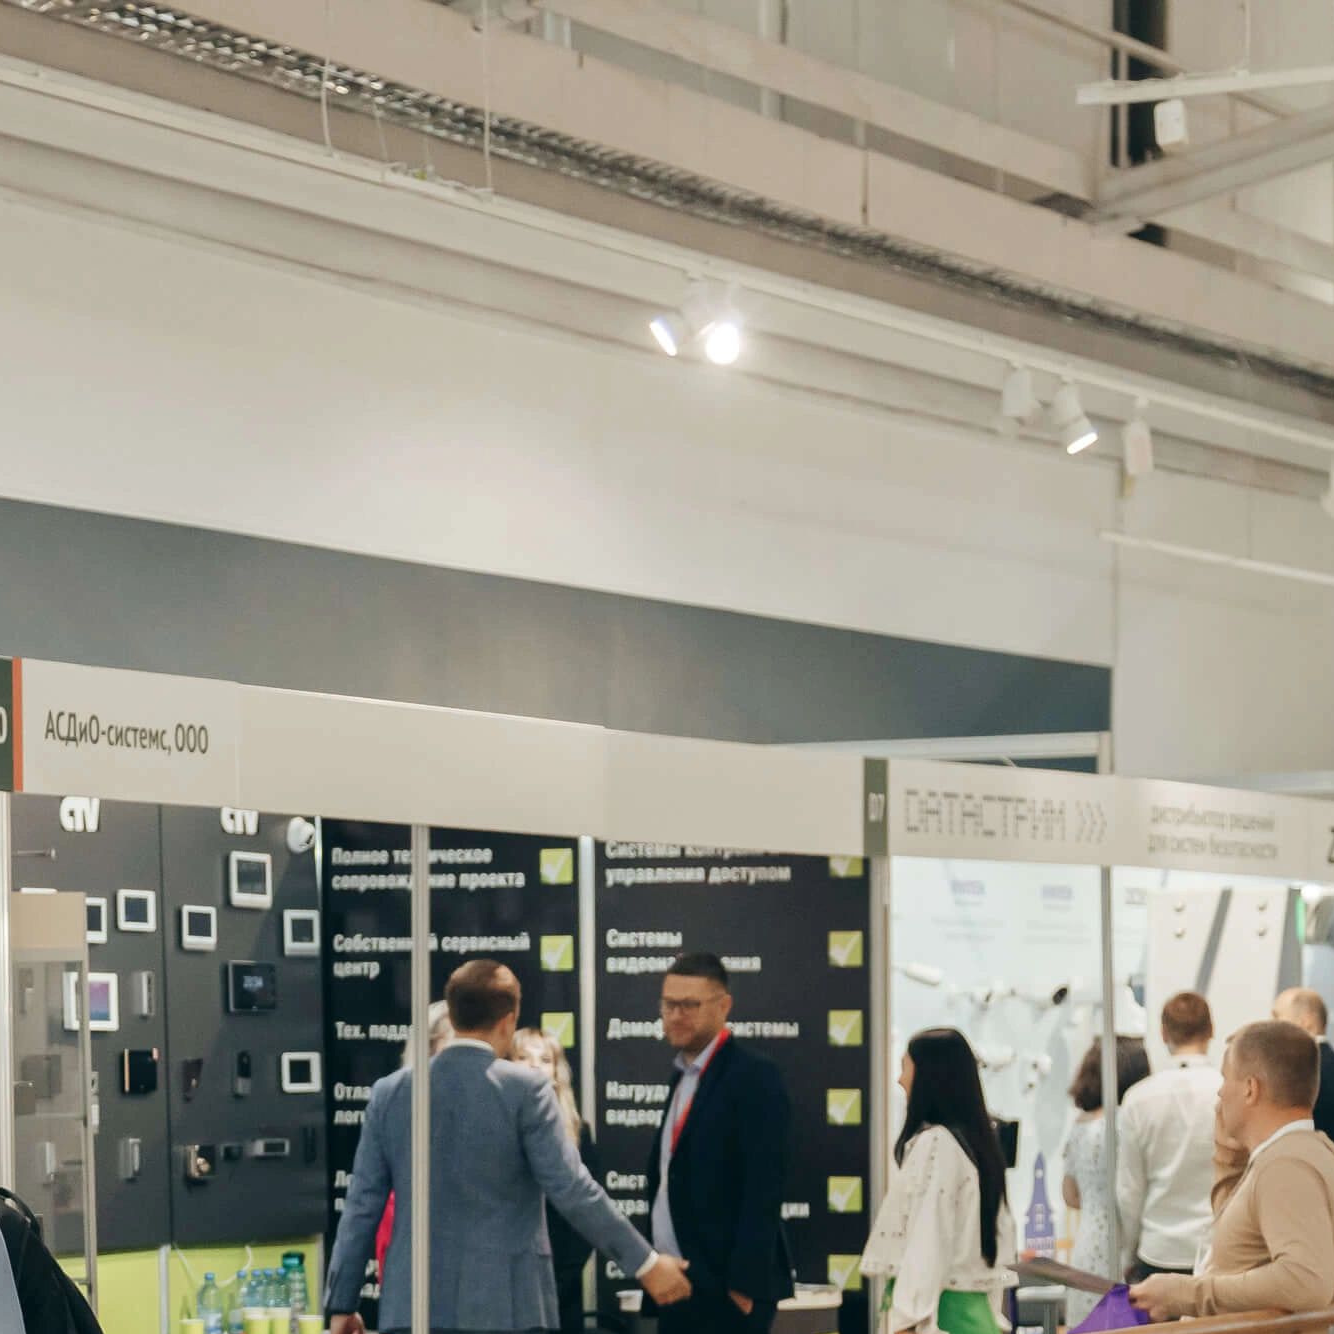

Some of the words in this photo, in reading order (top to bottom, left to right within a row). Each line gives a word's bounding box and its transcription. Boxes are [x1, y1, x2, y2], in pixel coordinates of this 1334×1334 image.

[174, 724, 209, 755] ООО
[59, 796, 100, 833] CTV
[393, 847, 493, 864] теическое
[333, 934, 439, 951] Собственнй
